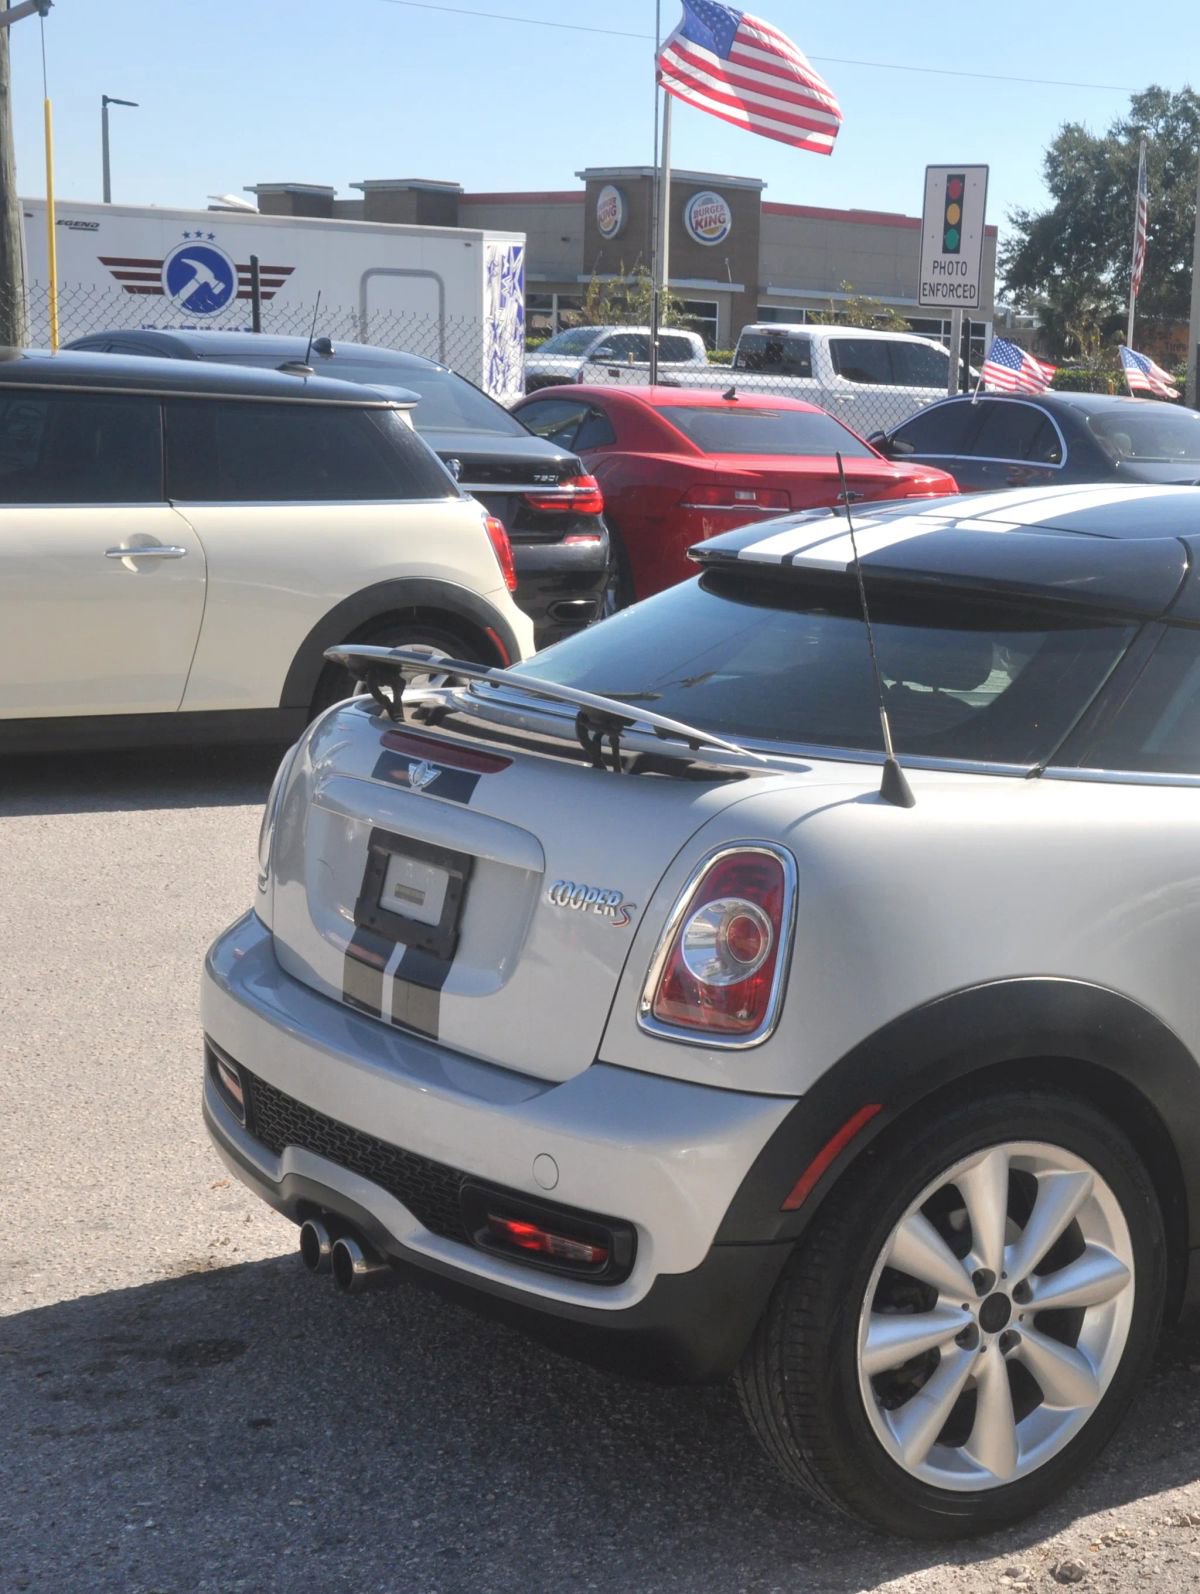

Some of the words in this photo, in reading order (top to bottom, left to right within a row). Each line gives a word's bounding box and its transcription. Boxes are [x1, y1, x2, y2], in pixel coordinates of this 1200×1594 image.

[693, 203, 725, 219] BURGER
[55, 219, 100, 229] EGEND
[694, 213, 727, 231] KING
[932, 260, 968, 276] PHOTO
[922, 282, 976, 299] ENFORCED
[548, 879, 625, 917] COOPER
[608, 903, 638, 928] S
